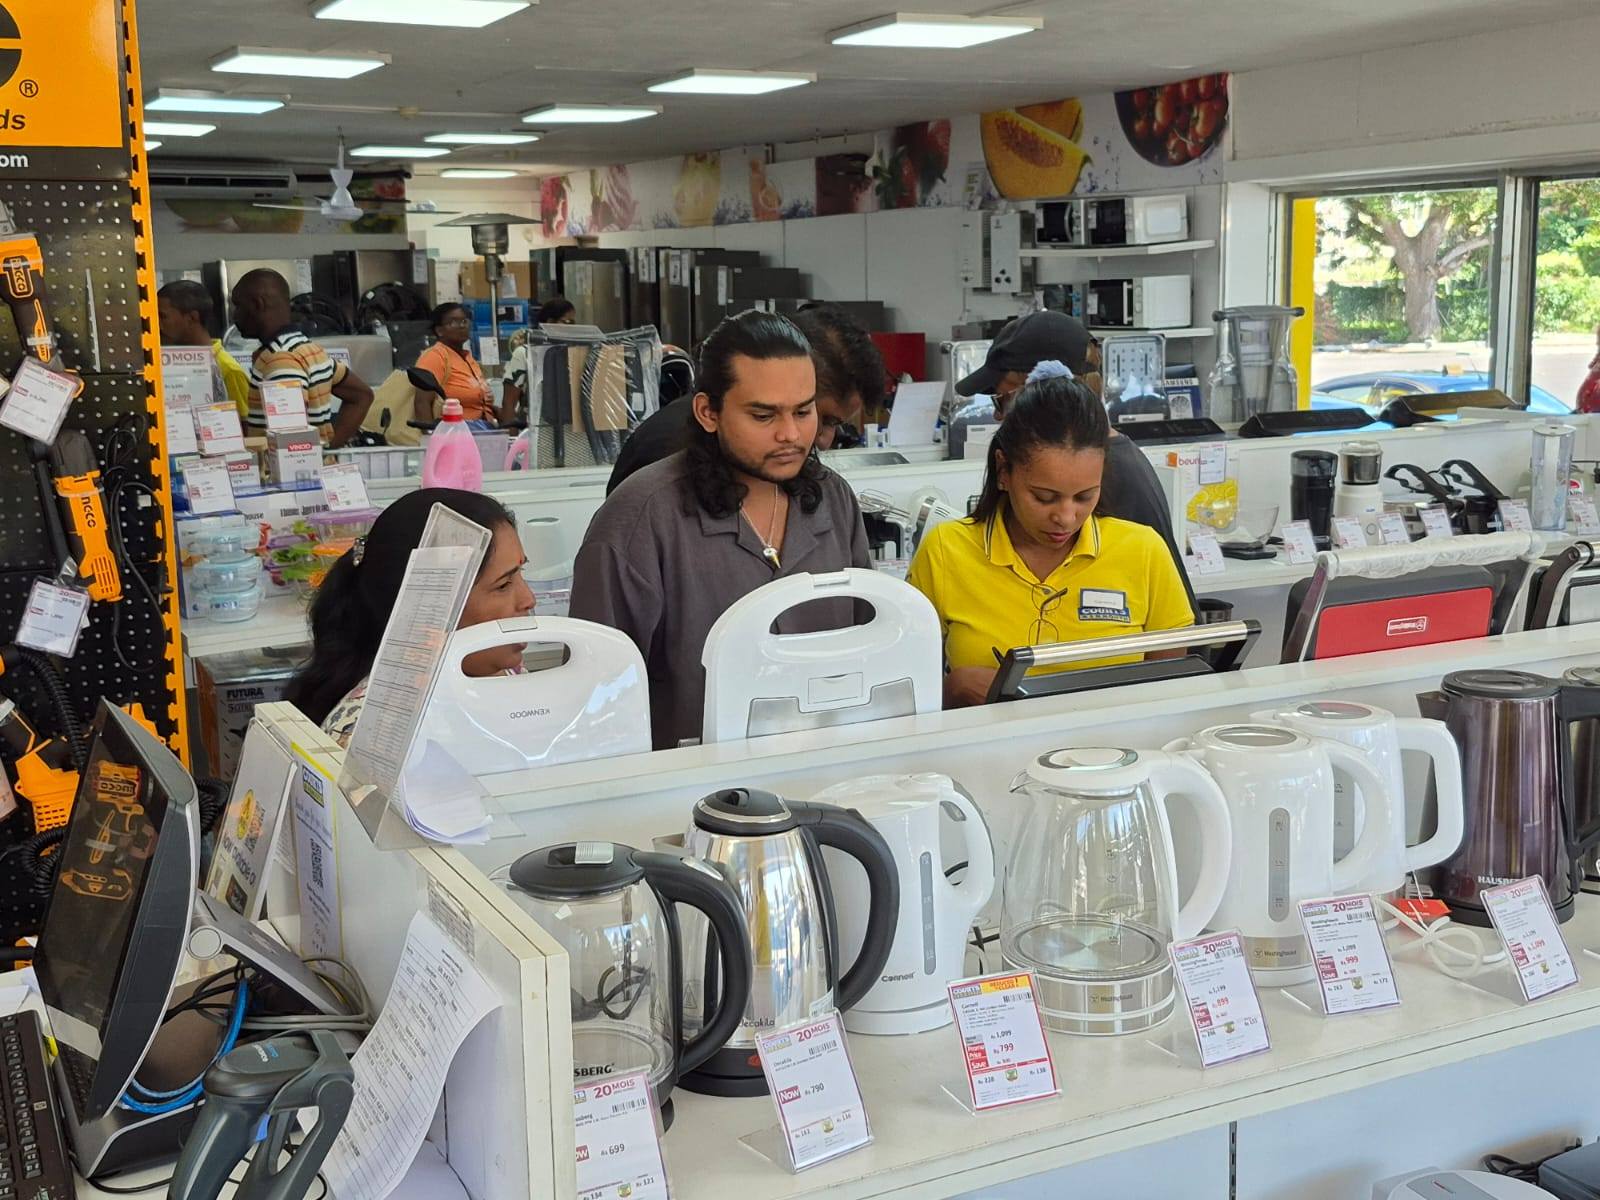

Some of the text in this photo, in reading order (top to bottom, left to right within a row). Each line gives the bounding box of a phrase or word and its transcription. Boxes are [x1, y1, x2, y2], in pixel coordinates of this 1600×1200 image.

[0, 109, 26, 130] ds
[0, 155, 29, 168] om
[81, 496, 97, 528] NGCO
[226, 687, 265, 698] FUTURA
[509, 708, 551, 720] KENWOOD
[1332, 902, 1346, 913] 20
[1202, 942, 1216, 955] 20
[1345, 955, 1359, 964] 999
[796, 1022, 831, 1043] 20 MOIS
[1000, 1042, 1014, 1052] 799
[574, 1063, 615, 1077] SBERG
[593, 1079, 636, 1099] 20 MOIS
[780, 1087, 800, 1102] Now
[810, 1083, 825, 1094] 790
[608, 1143, 625, 1155] 699
